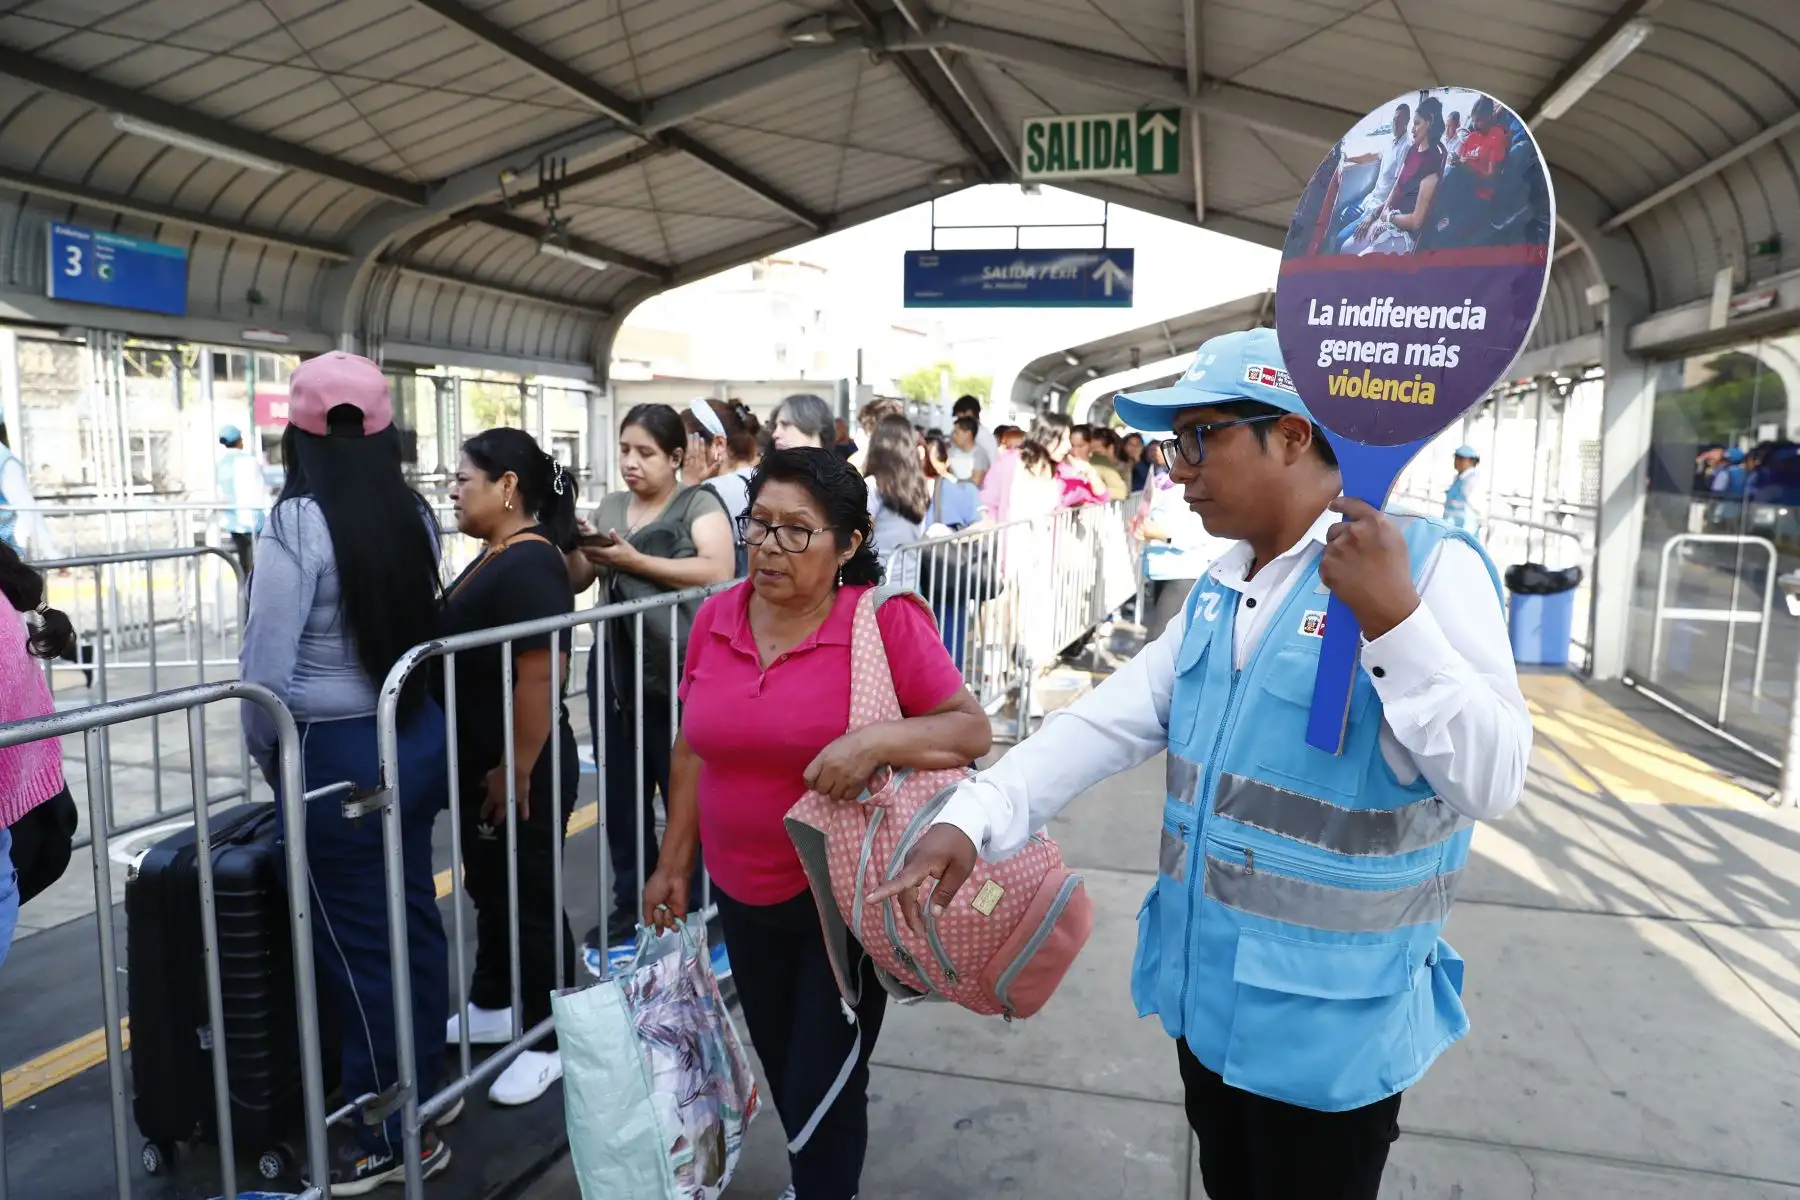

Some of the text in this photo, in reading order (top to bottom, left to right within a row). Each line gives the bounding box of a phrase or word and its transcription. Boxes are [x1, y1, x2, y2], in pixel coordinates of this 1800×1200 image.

[1027, 118, 1133, 173] SALIDA
[64, 245, 82, 277] 3
[982, 266, 1036, 280] SALIDA
[1050, 265, 1077, 280] Exit
[1308, 297, 1487, 330] La indiferencia
[1317, 337, 1461, 368] genera más
[1328, 368, 1436, 405] violencia
